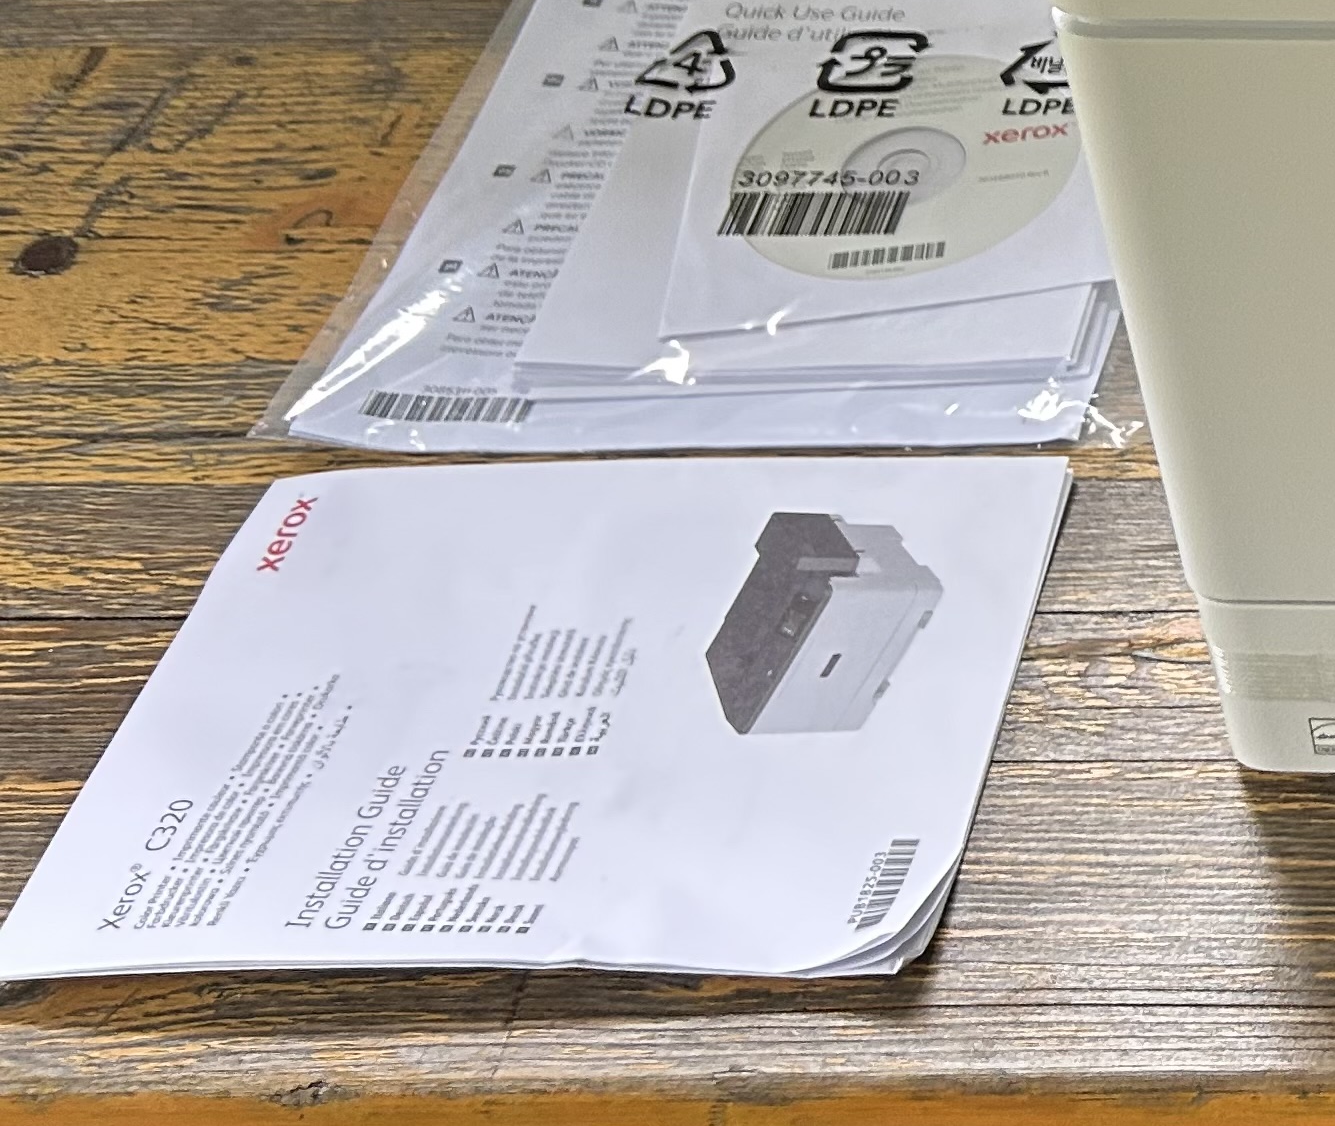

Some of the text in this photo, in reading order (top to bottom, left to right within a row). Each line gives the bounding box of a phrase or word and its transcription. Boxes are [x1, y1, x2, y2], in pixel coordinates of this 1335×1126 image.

[725, 2, 905, 21] Quick Use Guide
[718, 23, 781, 41] Guide
[624, 95, 717, 120] LDPE
[809, 98, 899, 118] LDPE
[983, 123, 1068, 145] xerox
[738, 170, 920, 187] 3097745-003
[256, 497, 318, 571] xerox
[145, 799, 194, 851] C320
[285, 765, 406, 929] Installation Guide
[325, 875, 377, 930] Guide
[367, 750, 450, 871] d'installation
[847, 851, 887, 924] PUB1825-003
